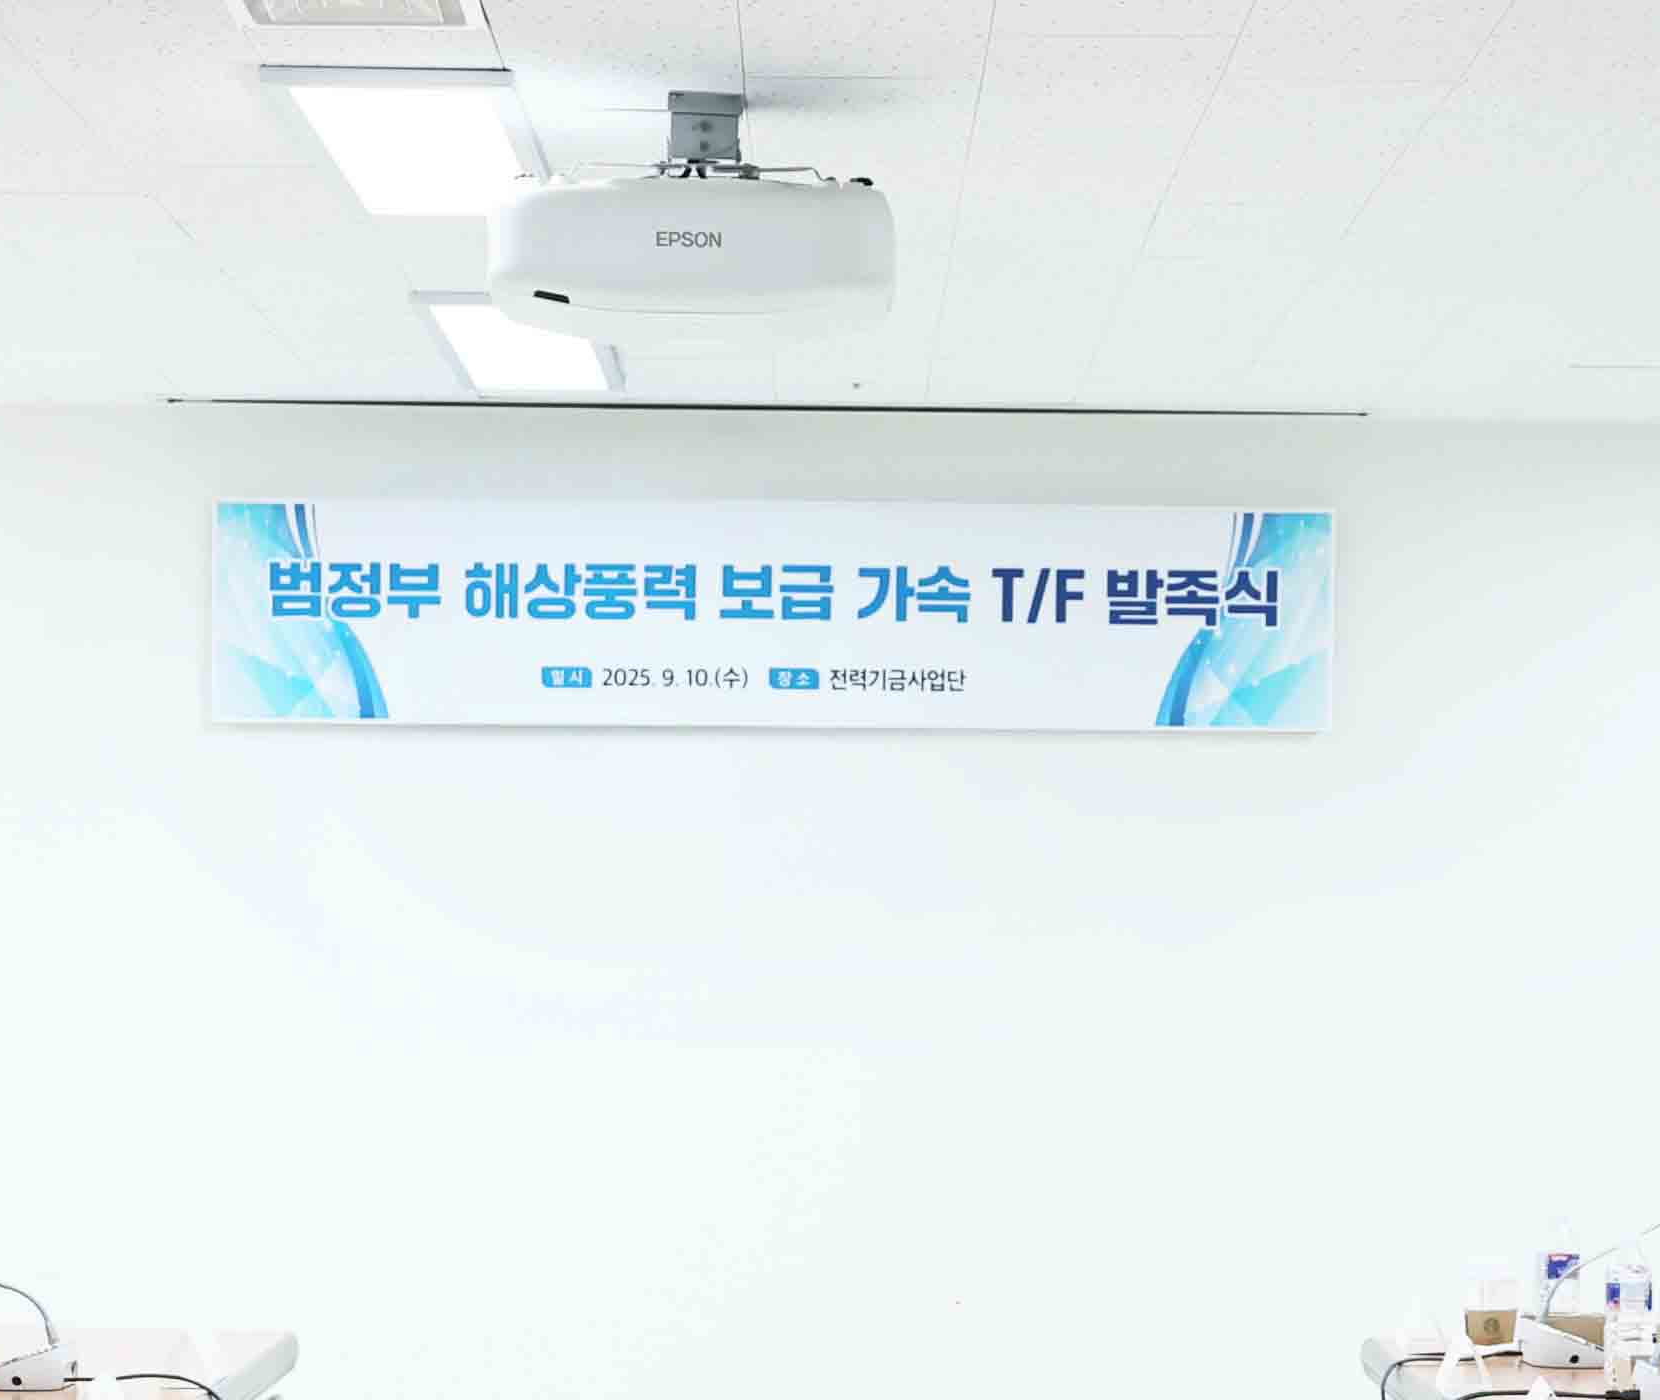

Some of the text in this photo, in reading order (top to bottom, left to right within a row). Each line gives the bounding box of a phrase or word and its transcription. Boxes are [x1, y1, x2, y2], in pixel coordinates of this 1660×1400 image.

[655, 231, 722, 249] EPSON
[269, 562, 1279, 627] 범정부 해상풍력 보급 가속 T/F 발족식
[602, 668, 656, 687] 2025.
[661, 668, 680, 687] 9.
[829, 668, 968, 692] 전력기금사업단
